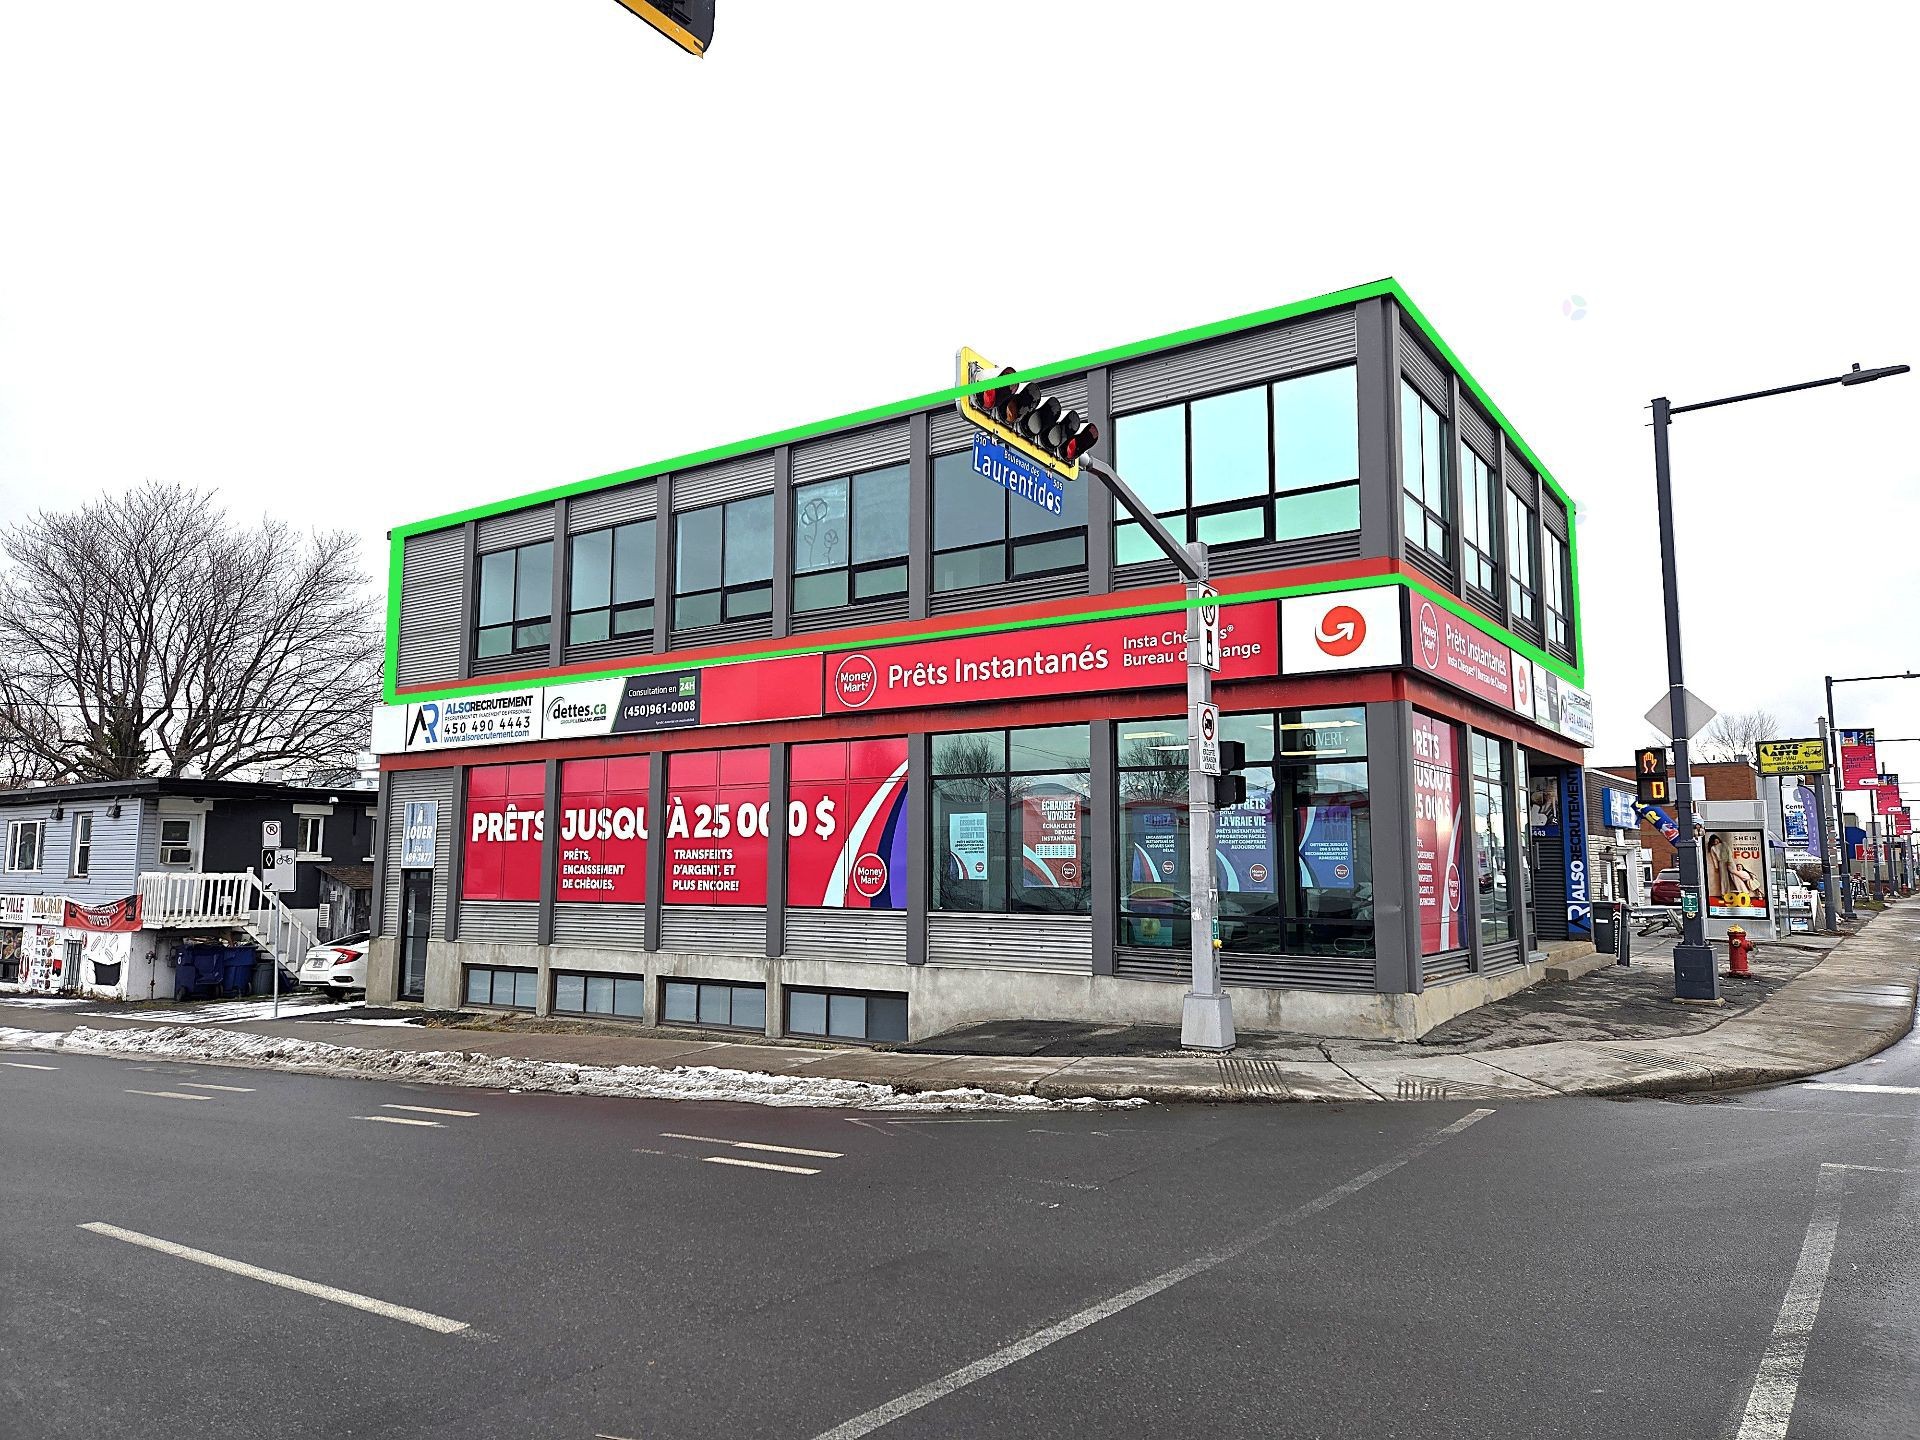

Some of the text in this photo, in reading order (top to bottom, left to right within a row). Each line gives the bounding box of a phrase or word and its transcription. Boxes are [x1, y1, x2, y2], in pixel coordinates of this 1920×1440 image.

[975, 434, 987, 447] 510
[1004, 449, 1040, 478] Boulevard des
[973, 445, 1062, 515] Laurentides
[1421, 620, 1437, 641] Money
[1123, 635, 1158, 650] Insta
[1445, 622, 1507, 677] Prêts Instantanés
[1123, 652, 1174, 667] Bureau
[1219, 643, 1261, 659] ange
[888, 643, 1109, 689] Prêts Instantanés
[840, 671, 872, 683] Money
[628, 687, 668, 698] Consultation
[668, 686, 677, 694] en
[552, 702, 607, 720] dettes.ca
[624, 699, 696, 719] (450)961-0008
[444, 716, 531, 735] 450 490 4443
[443, 730, 530, 743] www.alsorecrutement.com
[1304, 731, 1345, 747] OUVERT
[471, 803, 545, 842] PRÊTS
[694, 803, 731, 839] 25
[814, 795, 837, 841] $
[1047, 811, 1077, 821] VOYAGEZ
[1219, 815, 1267, 827] LA VRAIE VIE
[405, 825, 433, 840] LOUER
[563, 848, 591, 861] PRÊTS,
[673, 848, 733, 860] TRANSFERTS
[1733, 851, 1760, 860] FOU
[562, 864, 626, 875] ENCAISSEMENT
[673, 864, 736, 877] D'ARGENT, ET
[857, 867, 883, 878] Money
[562, 877, 615, 891] DE CHÈQUES,
[672, 879, 739, 892] PLUS ENCORE!
